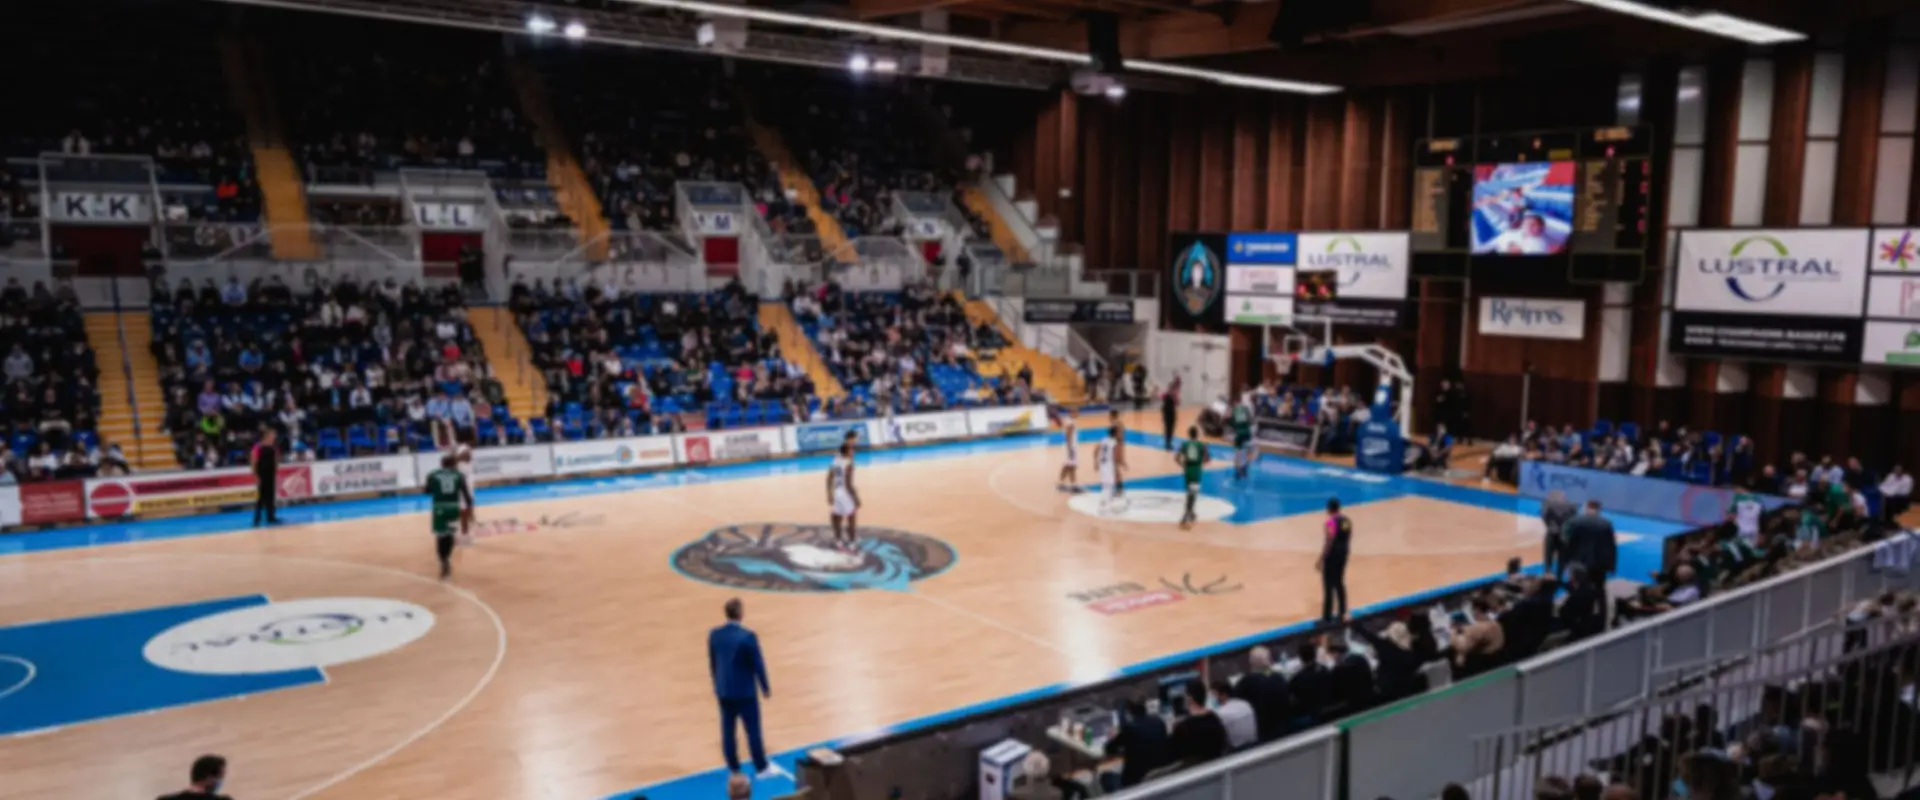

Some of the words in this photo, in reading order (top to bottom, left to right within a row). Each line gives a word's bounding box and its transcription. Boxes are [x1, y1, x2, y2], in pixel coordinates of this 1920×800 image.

[66, 195, 88, 217] K
[110, 196, 131, 218] K
[420, 206, 435, 226] L
[453, 206, 468, 226] L
[1698, 258, 1841, 275] LUSTRAL
[1490, 298, 1564, 327] Reims
